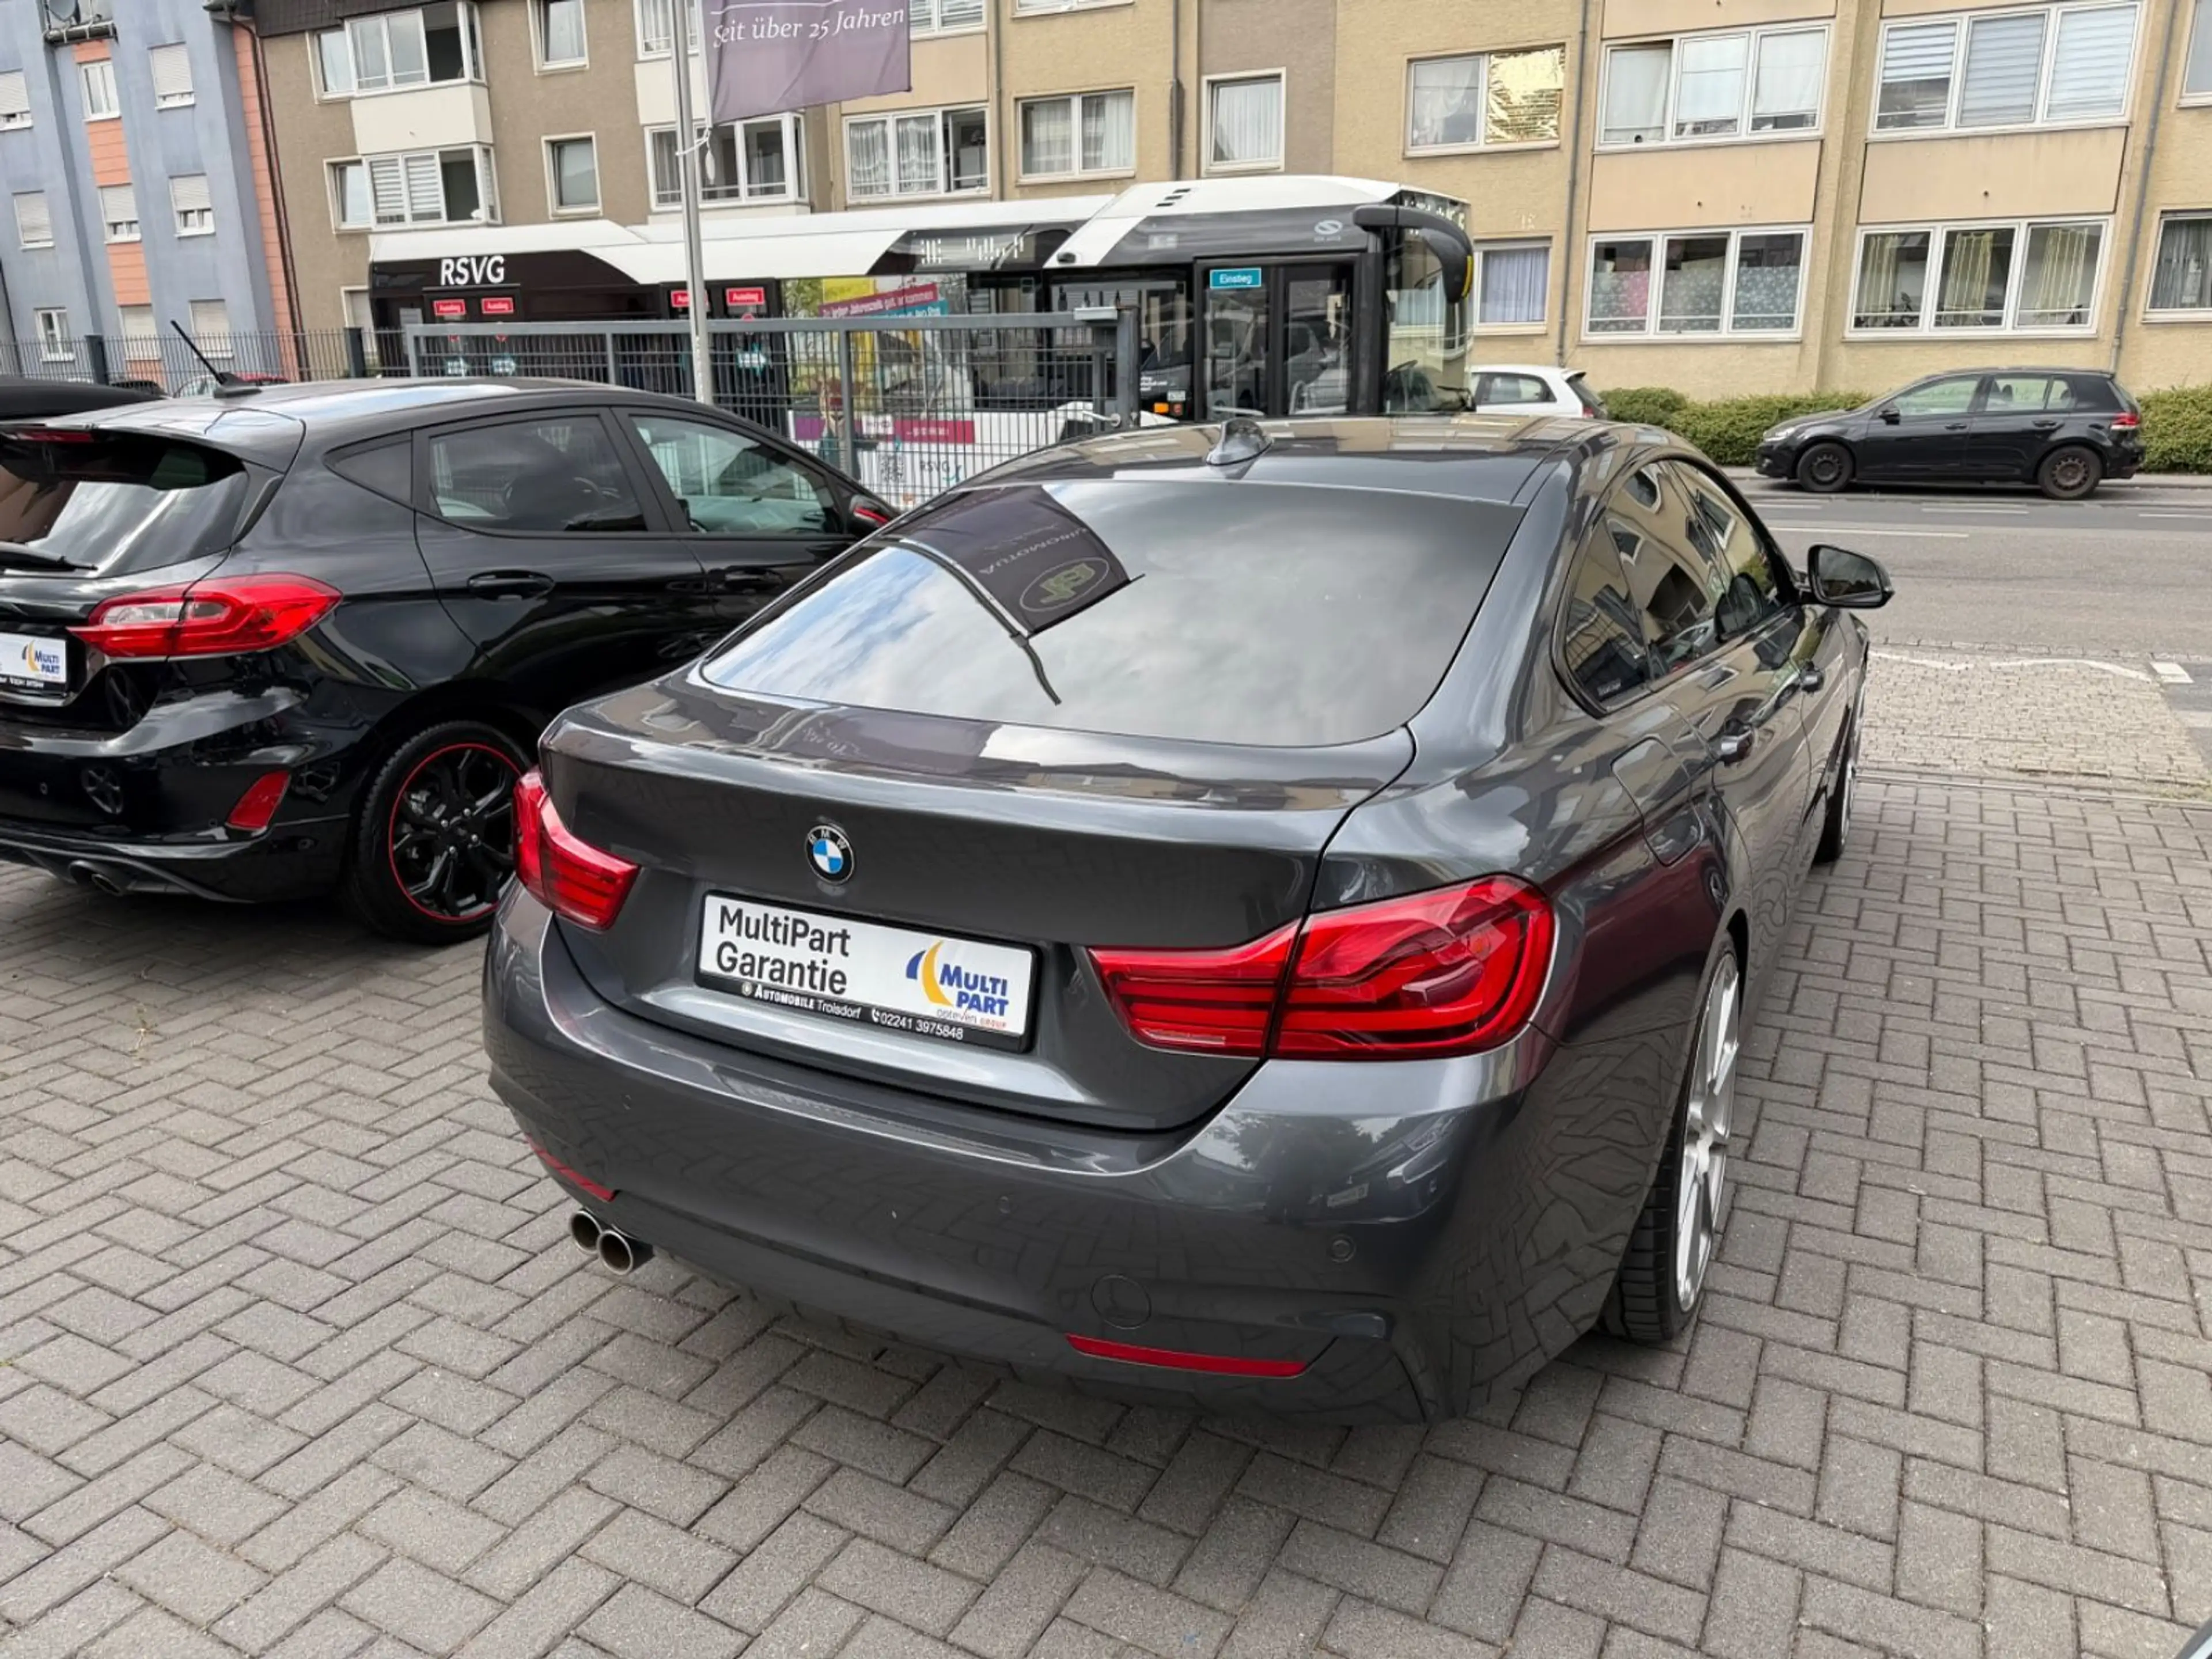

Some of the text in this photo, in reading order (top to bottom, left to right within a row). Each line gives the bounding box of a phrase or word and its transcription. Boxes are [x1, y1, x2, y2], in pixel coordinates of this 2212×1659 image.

[752, 16, 803, 39] über
[809, 21, 828, 39] 25
[832, 8, 904, 36] Jahren
[440, 255, 505, 286] RSVG
[719, 904, 851, 957] MultiPart
[716, 940, 847, 995] Garantie
[939, 963, 1008, 997] MULTI
[754, 984, 964, 1040] AUTOMOBILE Troisdorf 02241 3975848
[956, 991, 1010, 1017] PART
